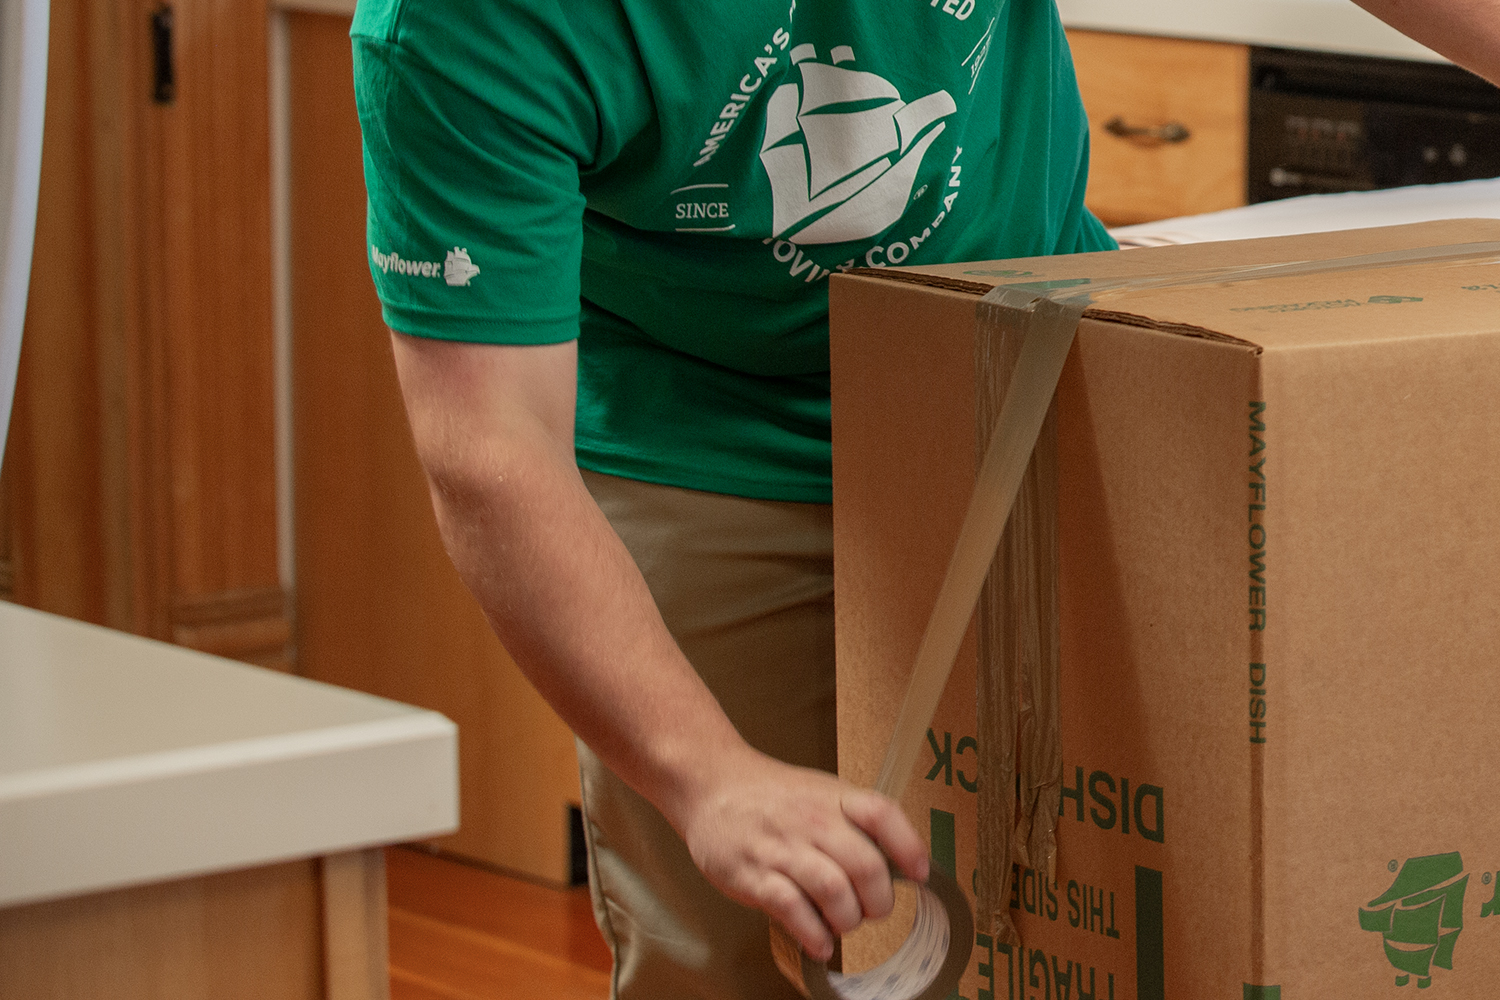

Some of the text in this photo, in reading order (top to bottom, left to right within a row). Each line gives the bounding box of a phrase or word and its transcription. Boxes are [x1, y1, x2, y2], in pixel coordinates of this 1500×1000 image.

[675, 202, 730, 219] SINCE
[865, 145, 963, 268] COMPANY
[1248, 401, 1267, 744] MAYFLOWER DISH
[1058, 761, 1165, 844] DISH
[1009, 861, 1059, 922] SIDE
[1066, 879, 1121, 940] THIS
